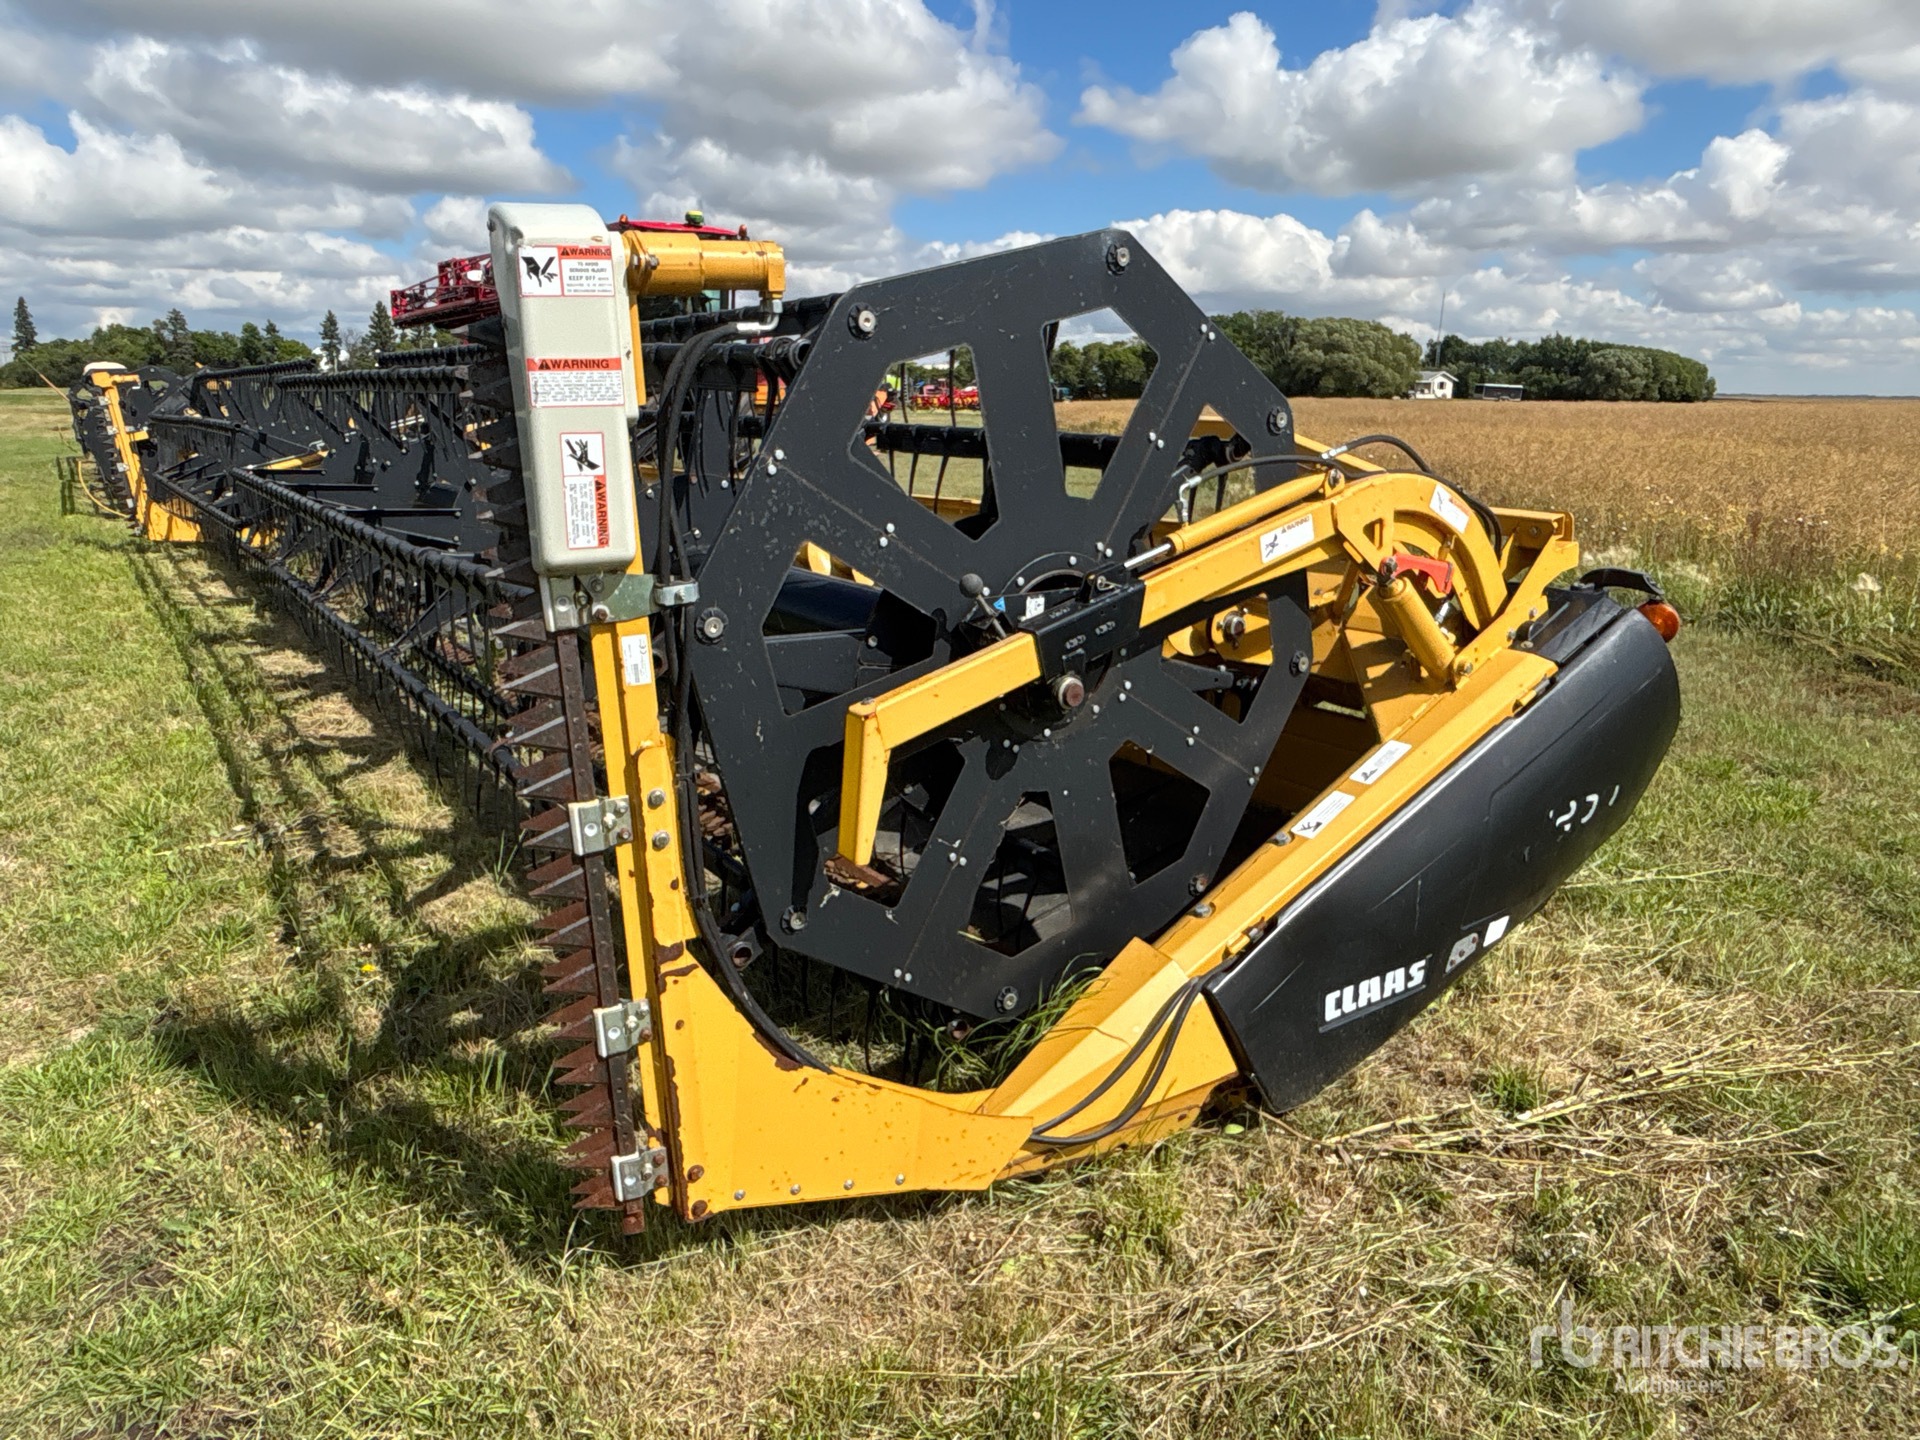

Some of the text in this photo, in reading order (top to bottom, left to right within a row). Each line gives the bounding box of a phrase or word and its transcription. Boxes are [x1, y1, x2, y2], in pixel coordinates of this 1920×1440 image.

[569, 248, 611, 256] WARNING
[551, 359, 609, 369] WARNING
[596, 490, 608, 545] WARNING
[1325, 960, 1426, 1022] CLAAS
